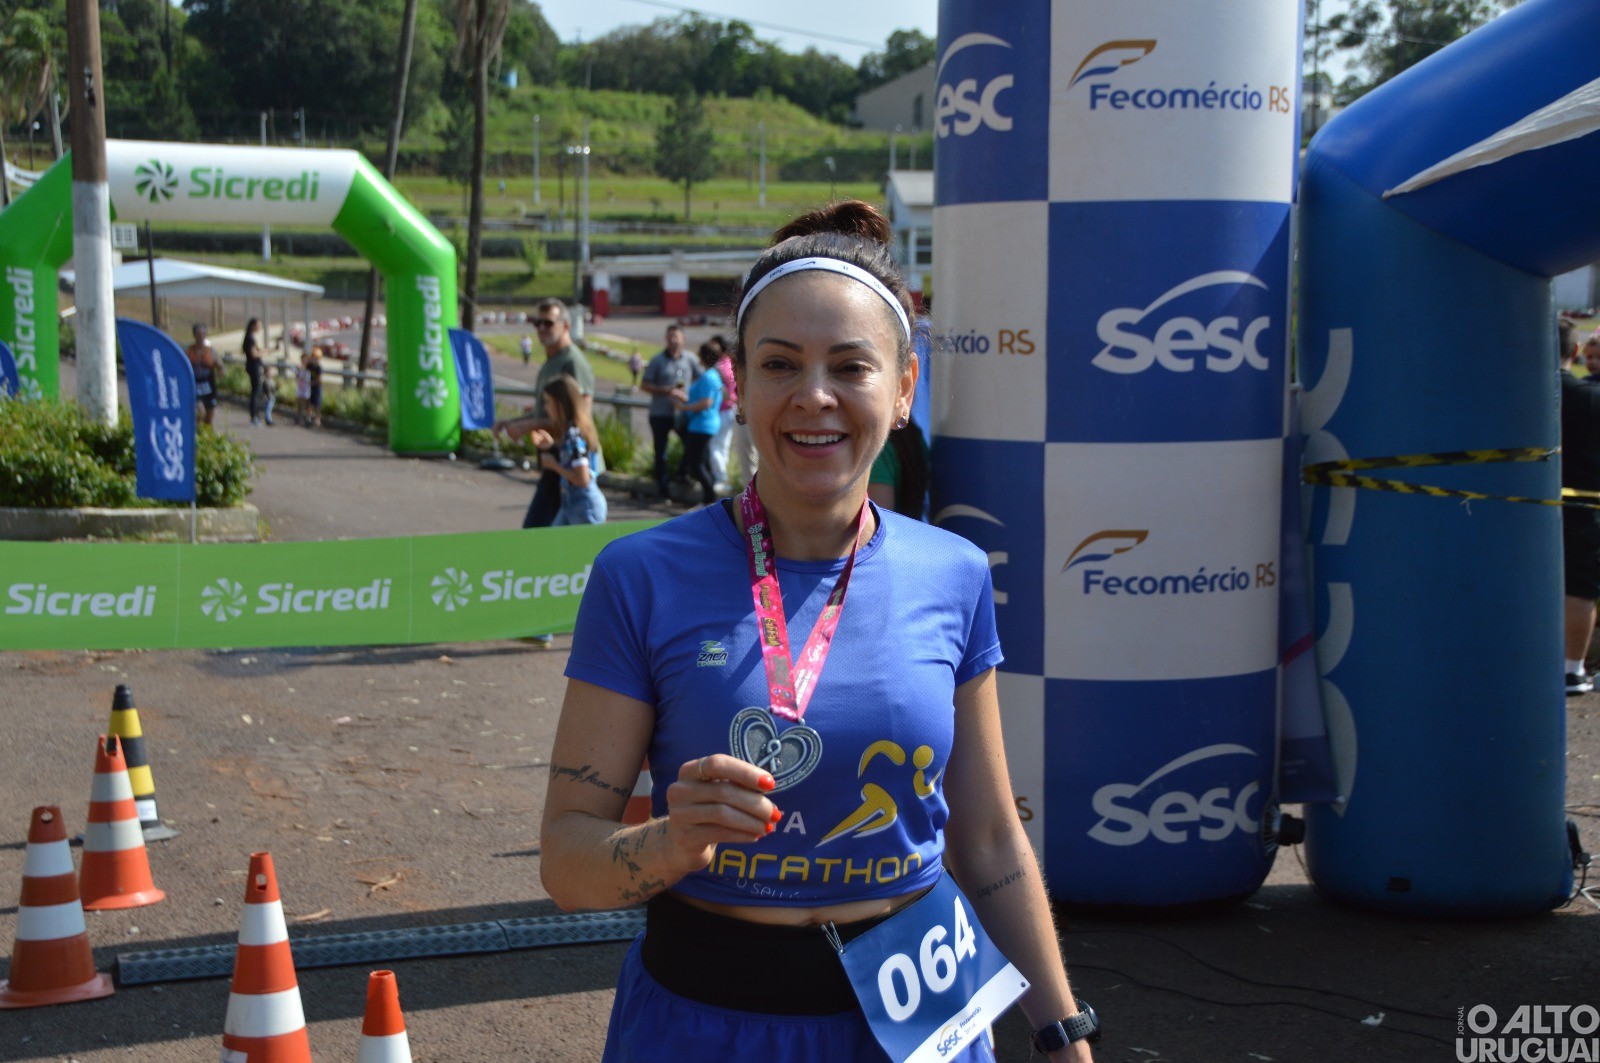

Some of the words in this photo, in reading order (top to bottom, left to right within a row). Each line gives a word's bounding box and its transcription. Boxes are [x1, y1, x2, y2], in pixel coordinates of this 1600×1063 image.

[1089, 81, 1262, 111] Fecomércio
[1268, 86, 1290, 114] RS
[188, 167, 320, 201] Sicredi
[416, 274, 443, 372] Sicredi
[1091, 307, 1270, 374] Sesc
[997, 329, 1035, 356] RS
[164, 416, 185, 483] Sesc
[1083, 567, 1250, 595] Fecomércio
[1255, 561, 1276, 589] RS
[5, 582, 157, 617] Sicredi
[255, 578, 391, 614] Sicredi
[1087, 780, 1259, 847] Sesc
[877, 895, 977, 1022] 064
[936, 1028, 963, 1057] Sesc
